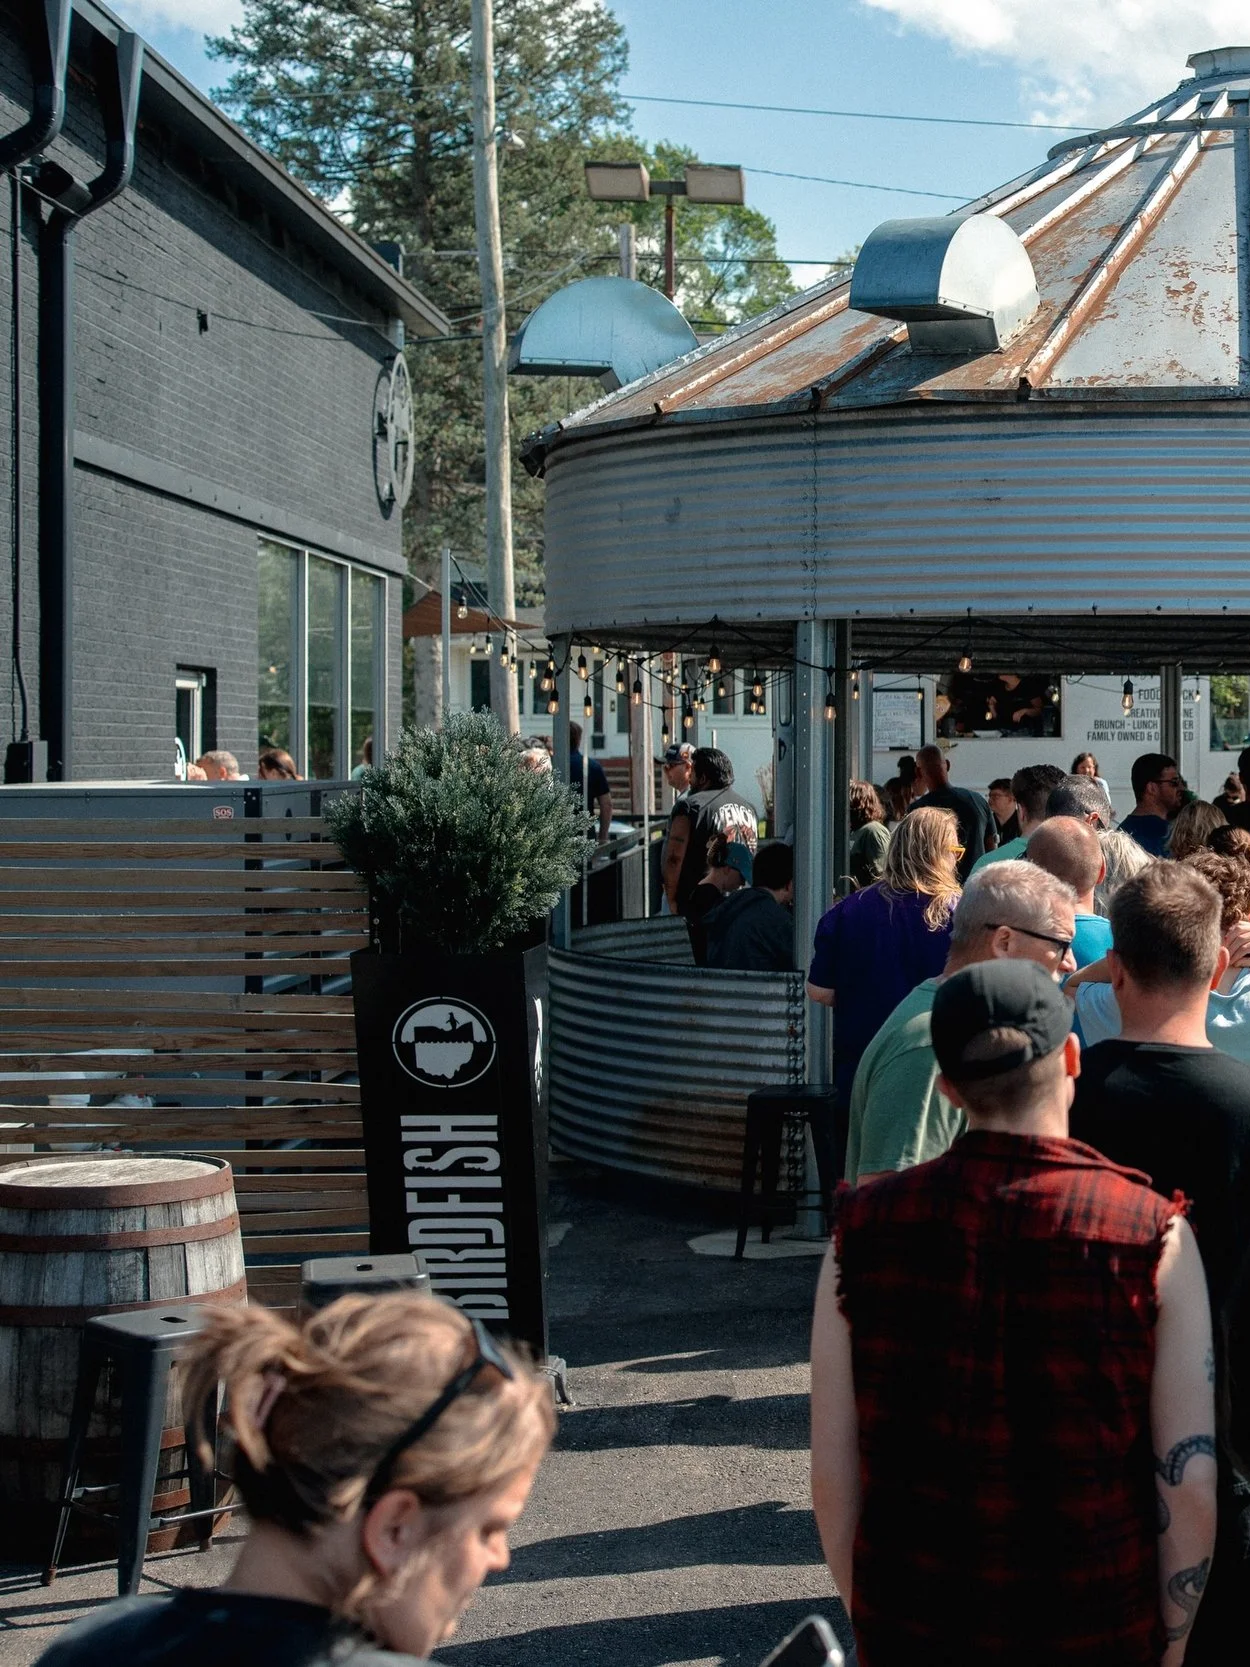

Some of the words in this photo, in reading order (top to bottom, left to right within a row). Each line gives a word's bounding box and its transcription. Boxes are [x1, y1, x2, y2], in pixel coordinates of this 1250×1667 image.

[1127, 708, 1161, 718] REATIVE
[1094, 719, 1125, 730] BRUNCH
[1132, 719, 1158, 730] LUNCH
[1087, 731, 1116, 741] FAMILY
[1117, 731, 1146, 741] OWNED
[215, 808, 232, 816] SOS
